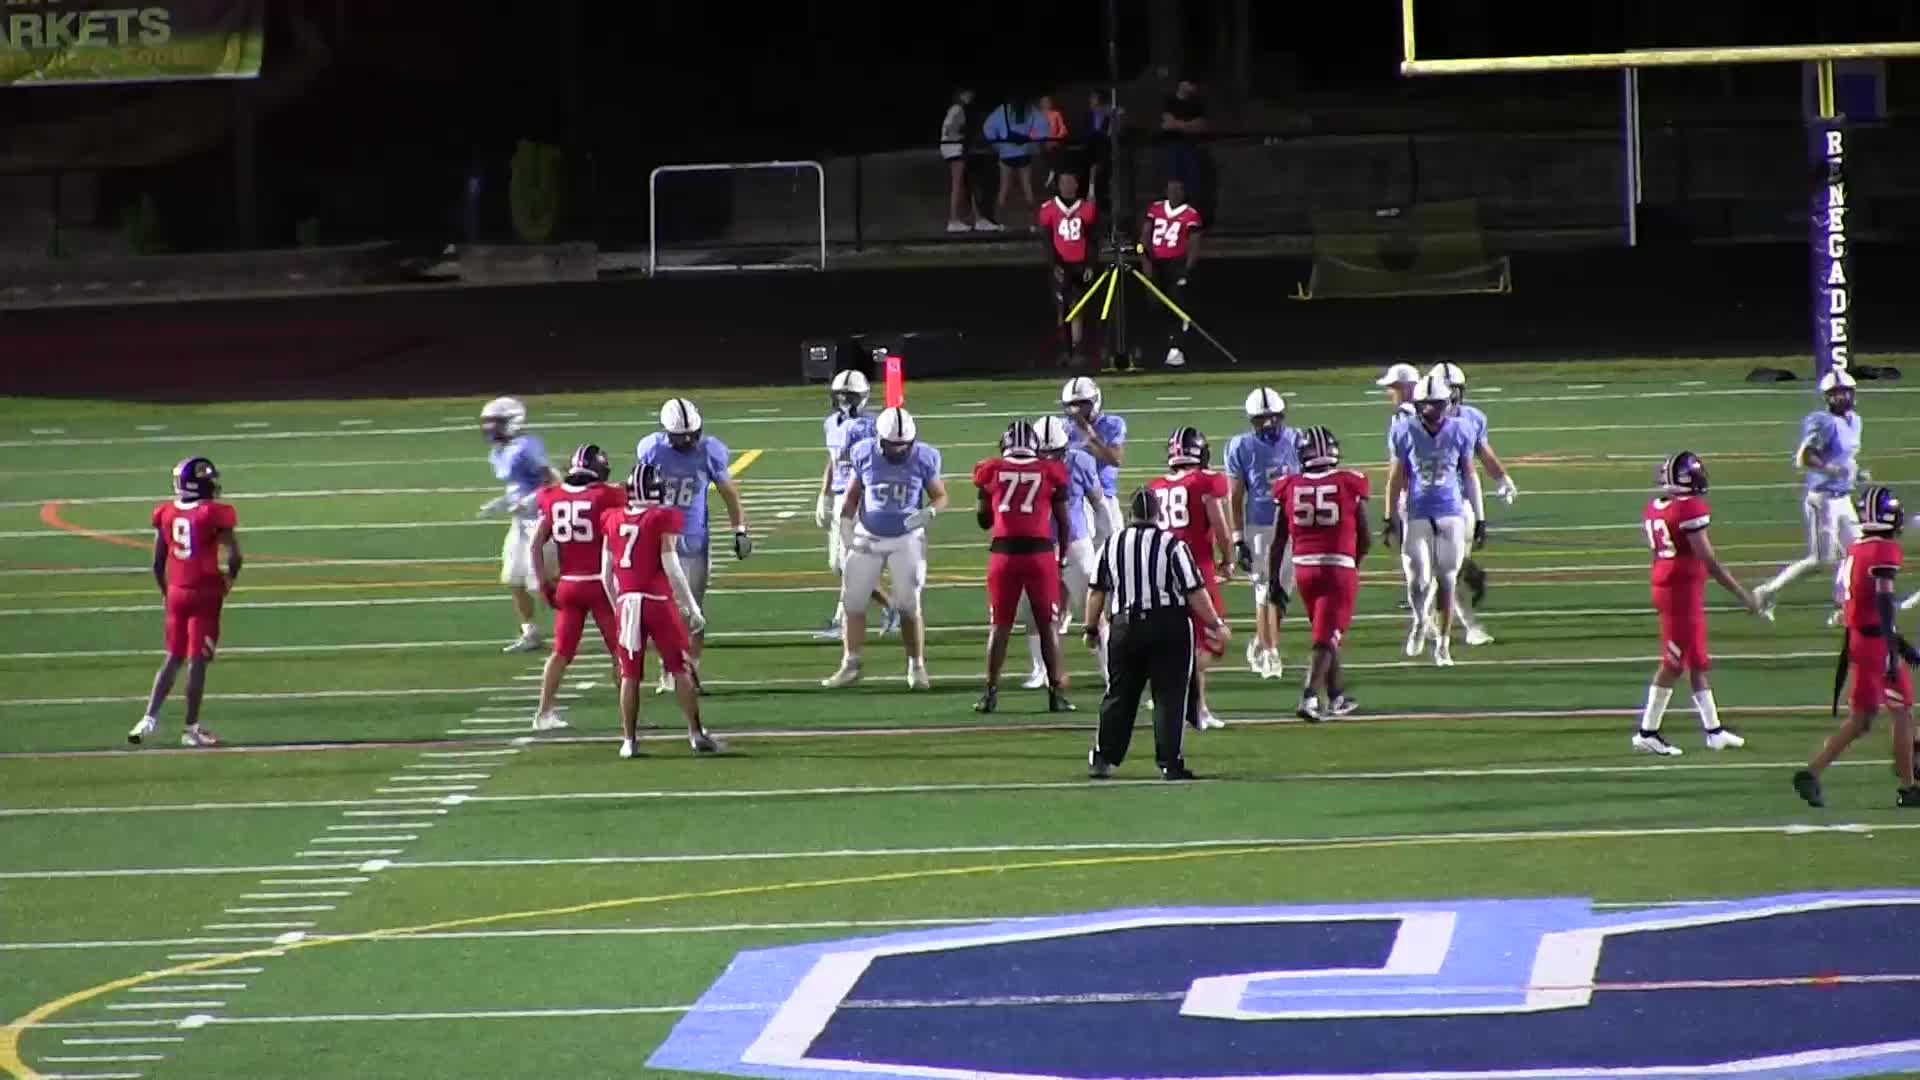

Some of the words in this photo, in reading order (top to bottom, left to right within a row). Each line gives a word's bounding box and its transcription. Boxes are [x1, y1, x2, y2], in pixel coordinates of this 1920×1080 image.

[0, 8, 171, 49] RKETS
[1058, 217, 1082, 241] 48
[1152, 217, 1181, 248] 24
[872, 482, 907, 508] 54
[999, 471, 1042, 513] 77
[1155, 486, 1190, 530] 38
[1293, 484, 1340, 528] 55
[172, 516, 192, 560] 9
[551, 500, 594, 542] 85
[1645, 518, 1678, 559] 13
[619, 524, 640, 568] 7
